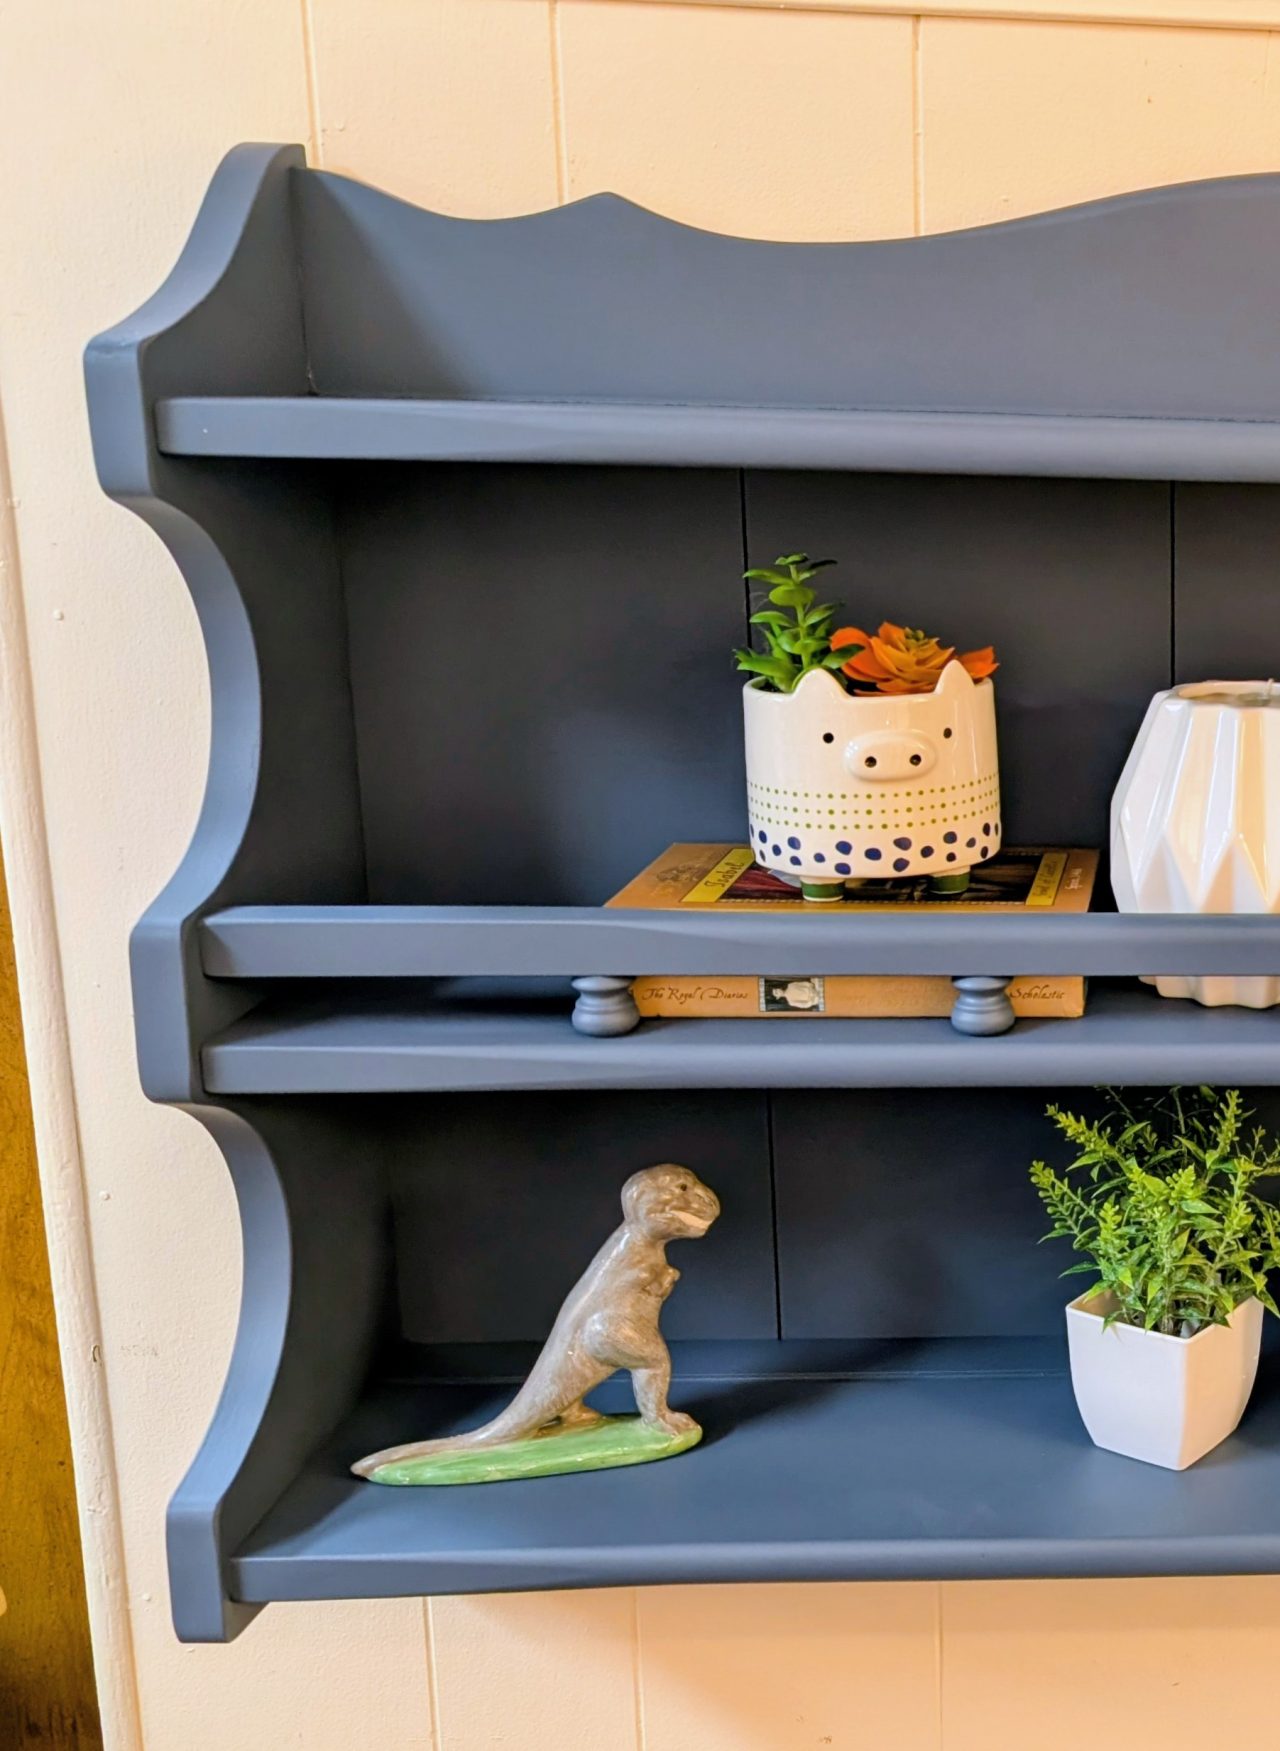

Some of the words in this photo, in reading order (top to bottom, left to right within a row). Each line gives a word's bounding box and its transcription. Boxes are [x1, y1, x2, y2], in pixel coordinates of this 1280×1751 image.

[704, 861, 745, 888] Isabel
[641, 986, 665, 1001] The
[668, 986, 702, 1005] Royal
[700, 987, 748, 1001] Diaries
[1009, 984, 1065, 1000] Scholastic
